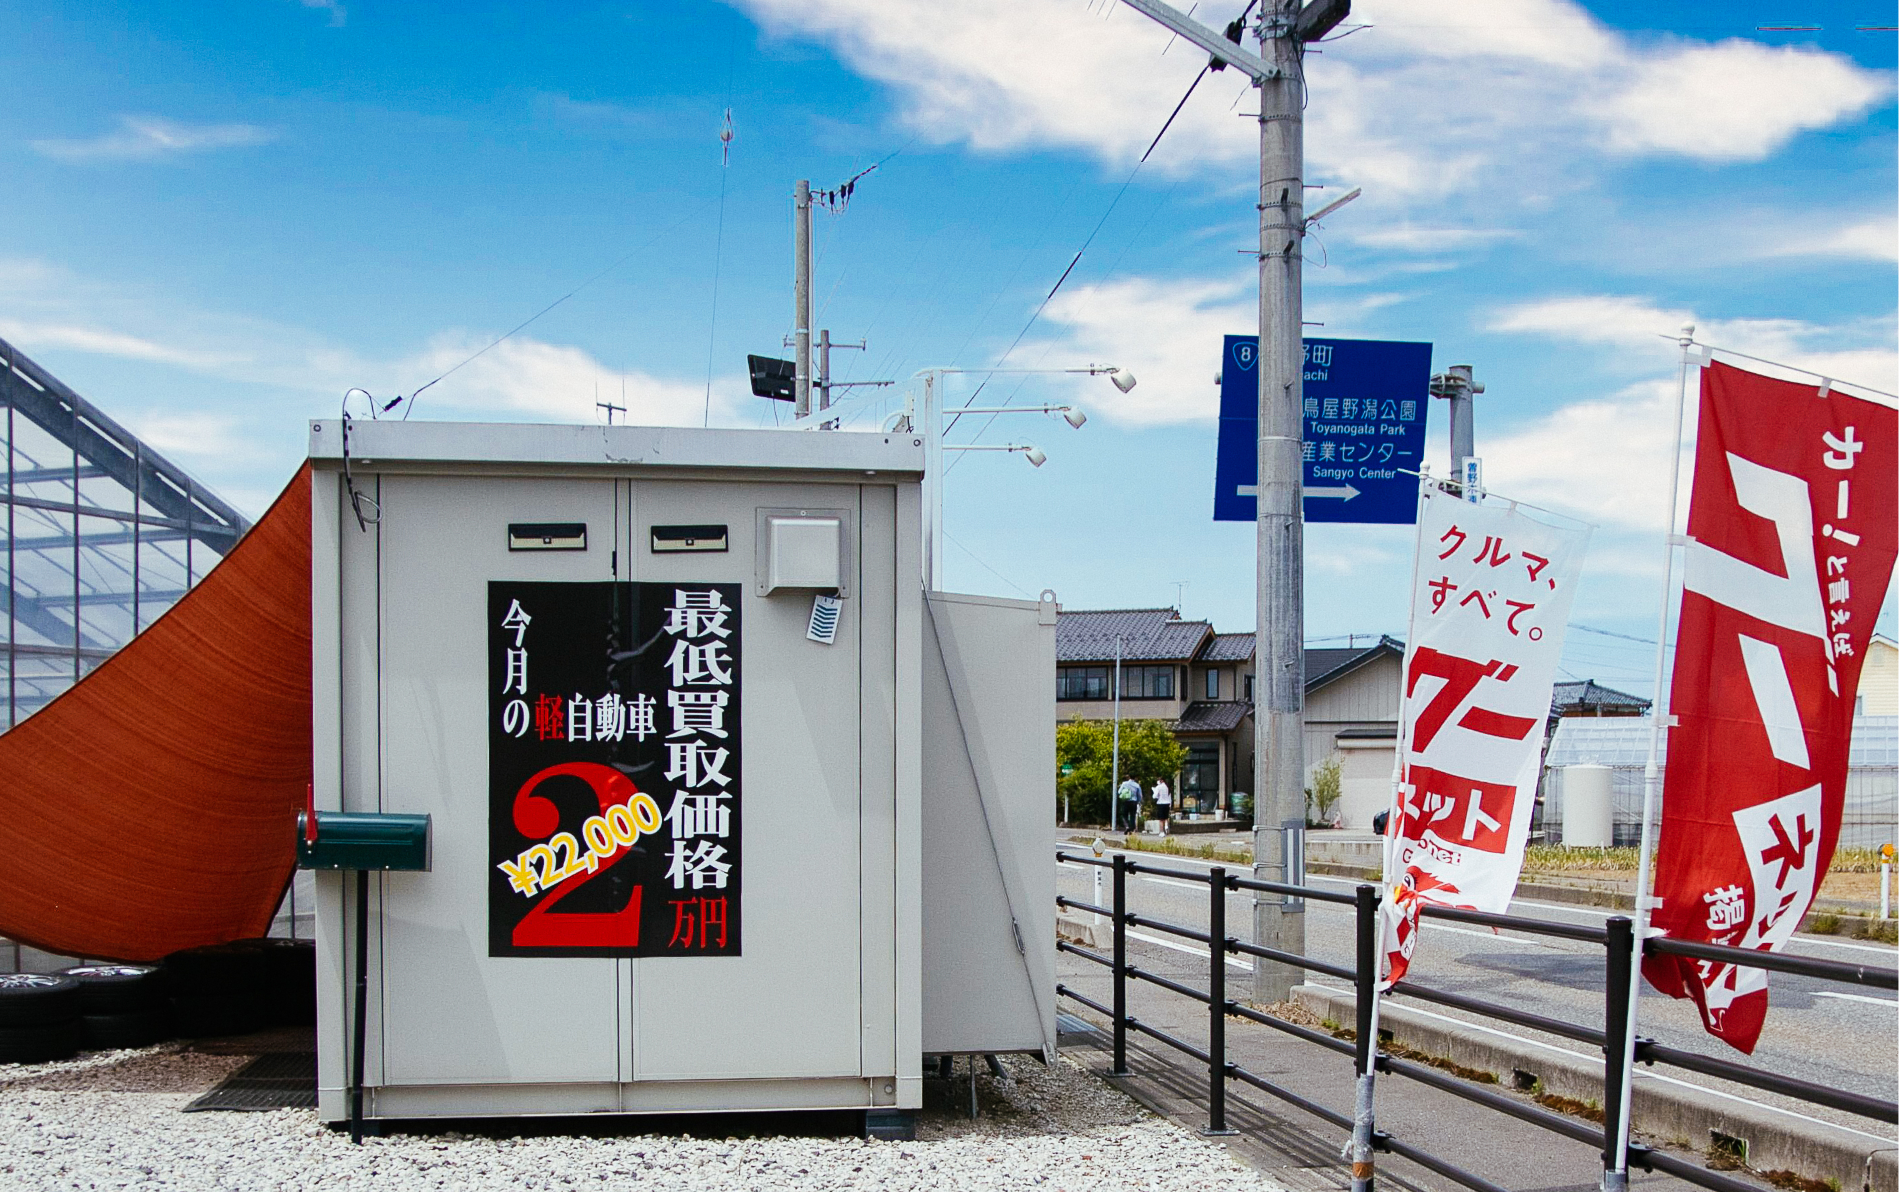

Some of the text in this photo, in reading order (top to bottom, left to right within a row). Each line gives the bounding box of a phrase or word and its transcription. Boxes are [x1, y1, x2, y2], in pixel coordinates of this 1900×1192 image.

[1241, 346, 1251, 362] 8
[1303, 369, 1328, 381] achi
[1302, 396, 1416, 421] 鳥屋野潟公園
[1310, 421, 1406, 436] Toyanogata Park
[1301, 440, 1413, 463] 産業センター
[1313, 465, 1397, 480] Sangyo Center
[1438, 523, 1558, 590] クルマ、
[1428, 575, 1544, 642] すべて。
[501, 598, 532, 738] 今月の
[534, 692, 658, 742] 軽自動車
[1406, 645, 1538, 753] グー
[663, 588, 733, 890] 最低買取価格
[497, 792, 662, 898] ¥22,000
[511, 761, 728, 949] 2 万円
